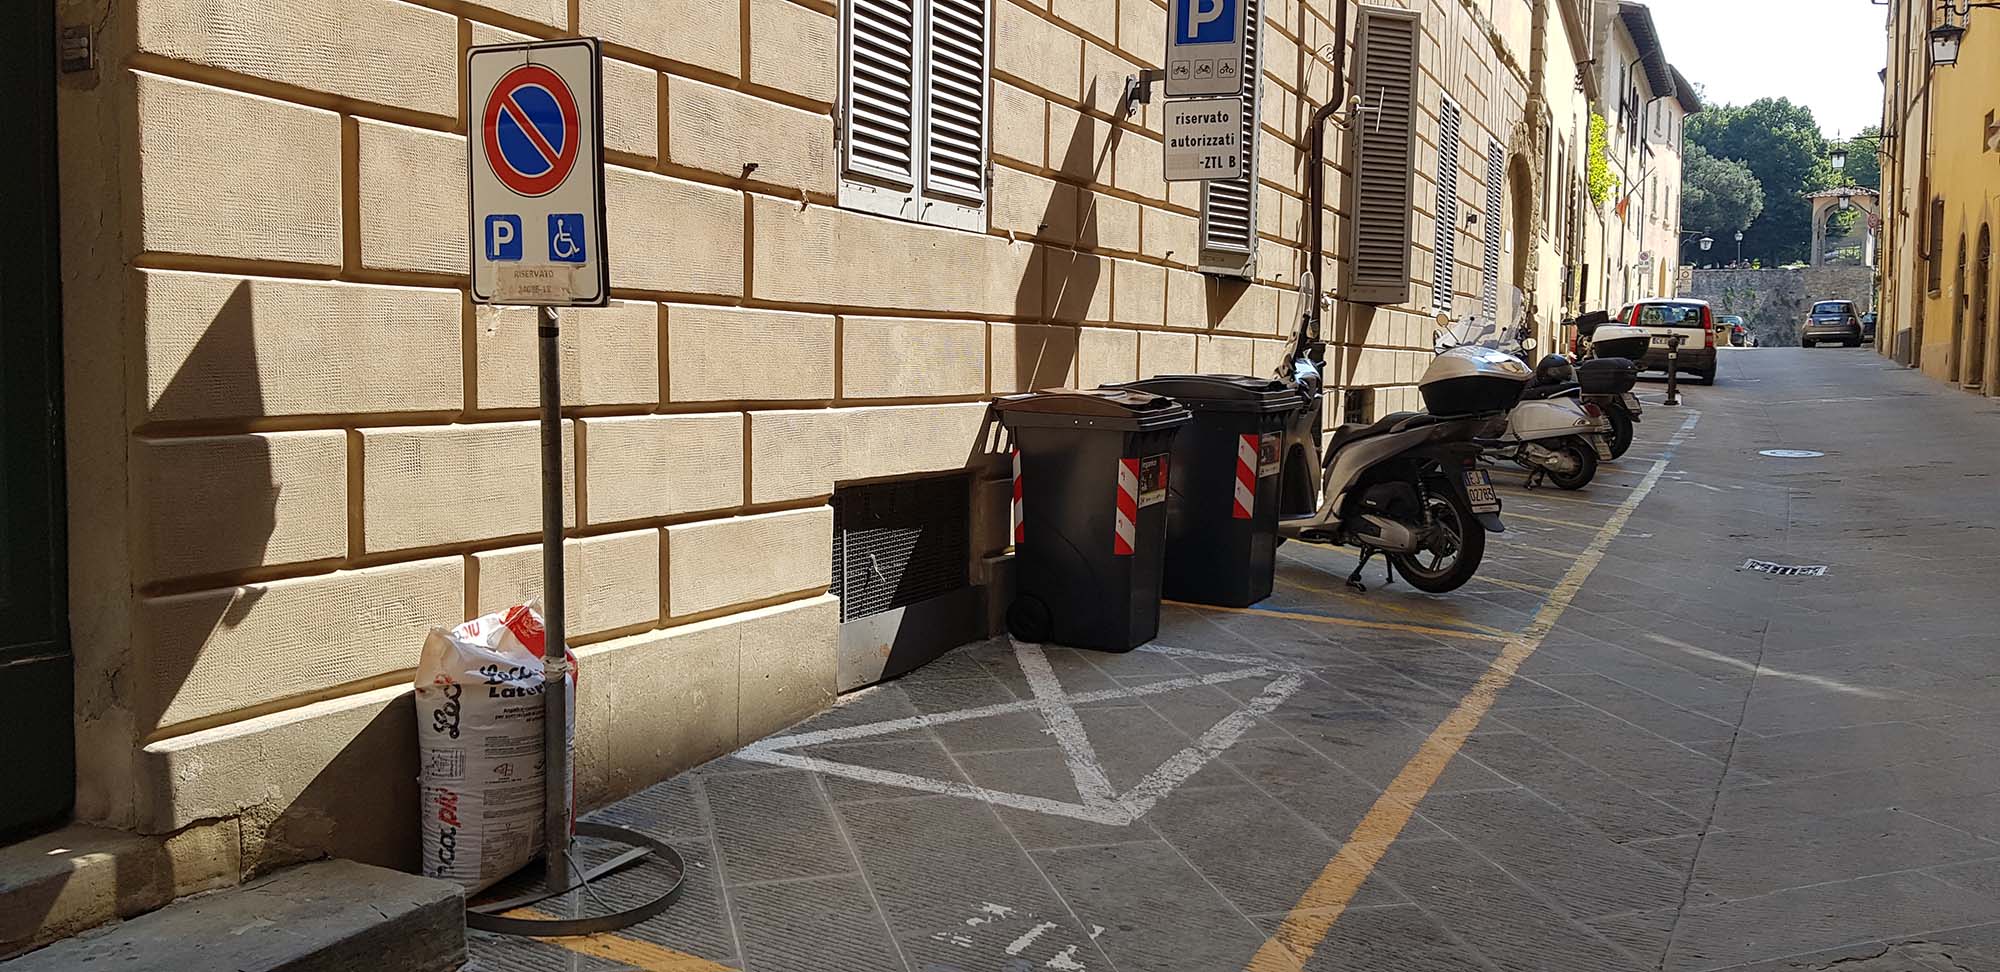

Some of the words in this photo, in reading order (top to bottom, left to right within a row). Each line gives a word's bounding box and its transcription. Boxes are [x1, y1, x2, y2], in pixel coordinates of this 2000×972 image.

[1187, 0, 1225, 39] P
[1175, 110, 1229, 125] riservato
[1170, 132, 1235, 148] autorizzati
[1228, 155, 1236, 168] B
[492, 219, 515, 257] P
